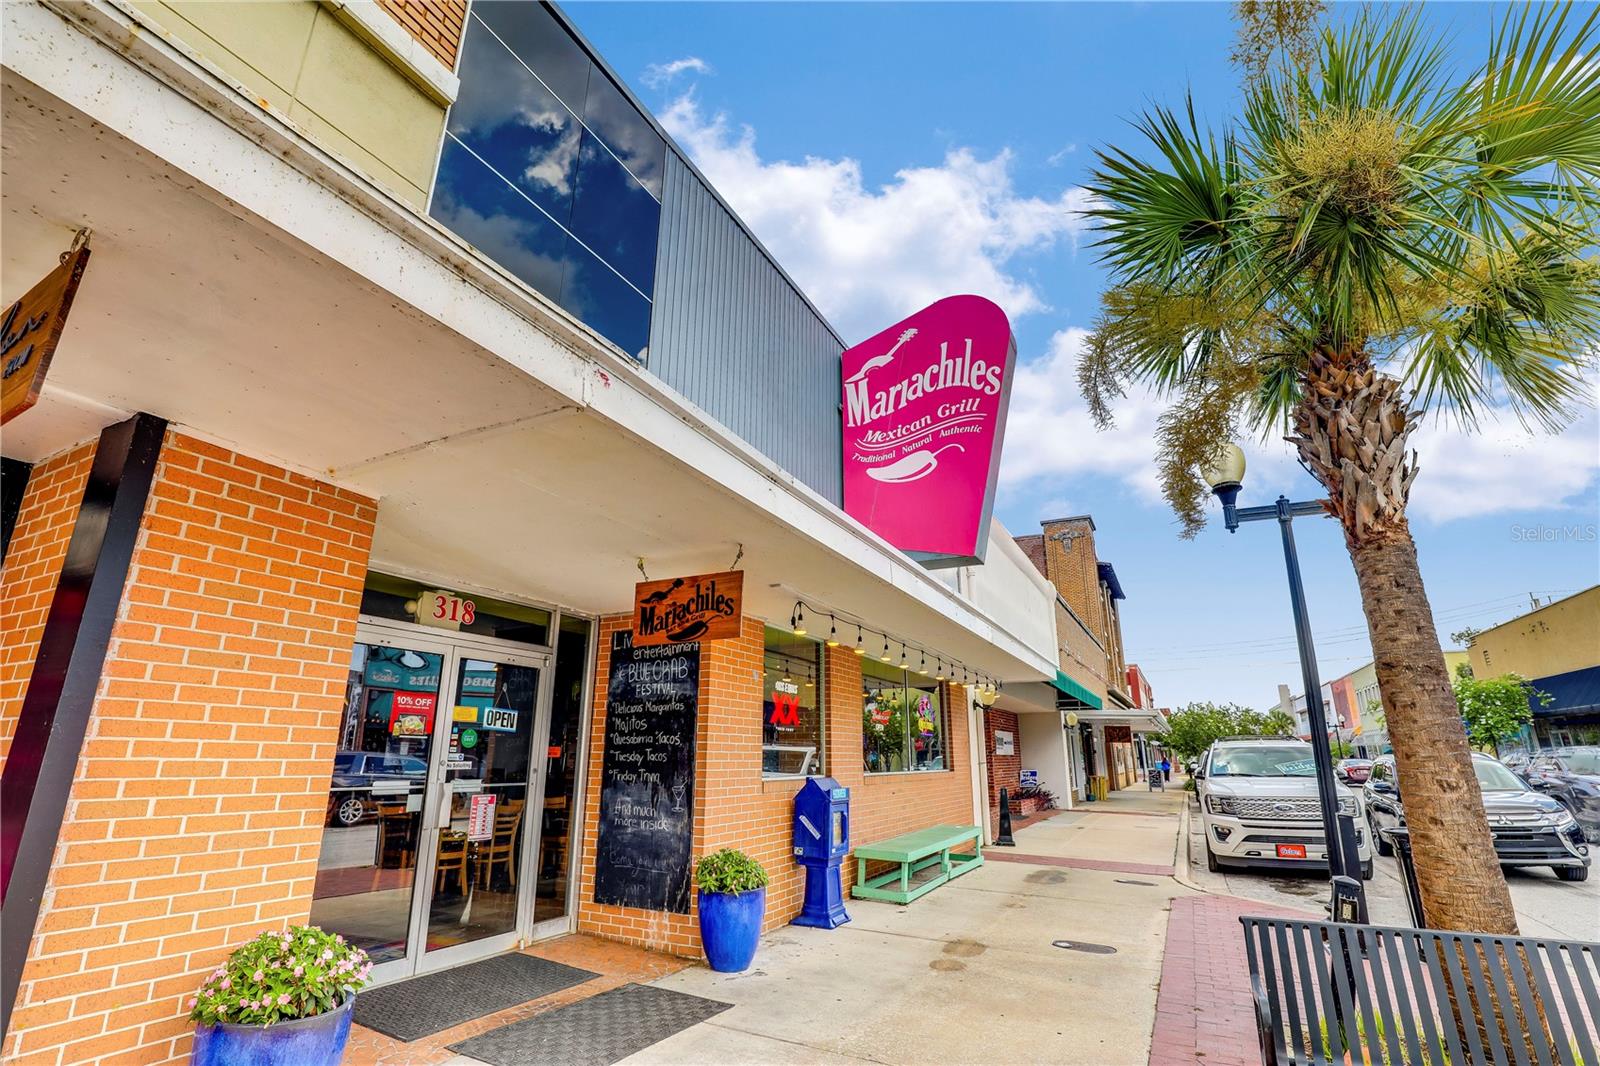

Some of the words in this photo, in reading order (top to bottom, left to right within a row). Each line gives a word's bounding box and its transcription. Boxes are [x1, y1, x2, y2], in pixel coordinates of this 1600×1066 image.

[844, 338, 1001, 428] Mariachiles
[863, 414, 931, 443] Mexican
[937, 398, 980, 418] Grill
[852, 450, 896, 463] Traditional
[902, 434, 932, 454] Natural
[939, 424, 982, 438] Authentic
[432, 595, 476, 625] 318
[638, 580, 734, 636] Mariachiles
[613, 632, 633, 650] Liv
[633, 641, 699, 660] entertainment
[628, 662, 651, 683] BLUE
[653, 656, 688, 682] CRAB
[635, 682, 676, 697] FESTIVAL
[397, 696, 413, 705] 10%
[415, 698, 432, 706] OFF
[769, 692, 801, 727] XX
[486, 710, 516, 729] OPEN
[615, 715, 647, 733] Mojitos
[613, 751, 644, 766] Tuesday
[645, 748, 668, 762] Tacos
[613, 769, 637, 783] Friday
[633, 806, 656, 817] much
[614, 818, 637, 827] more
[640, 815, 670, 831] inside
